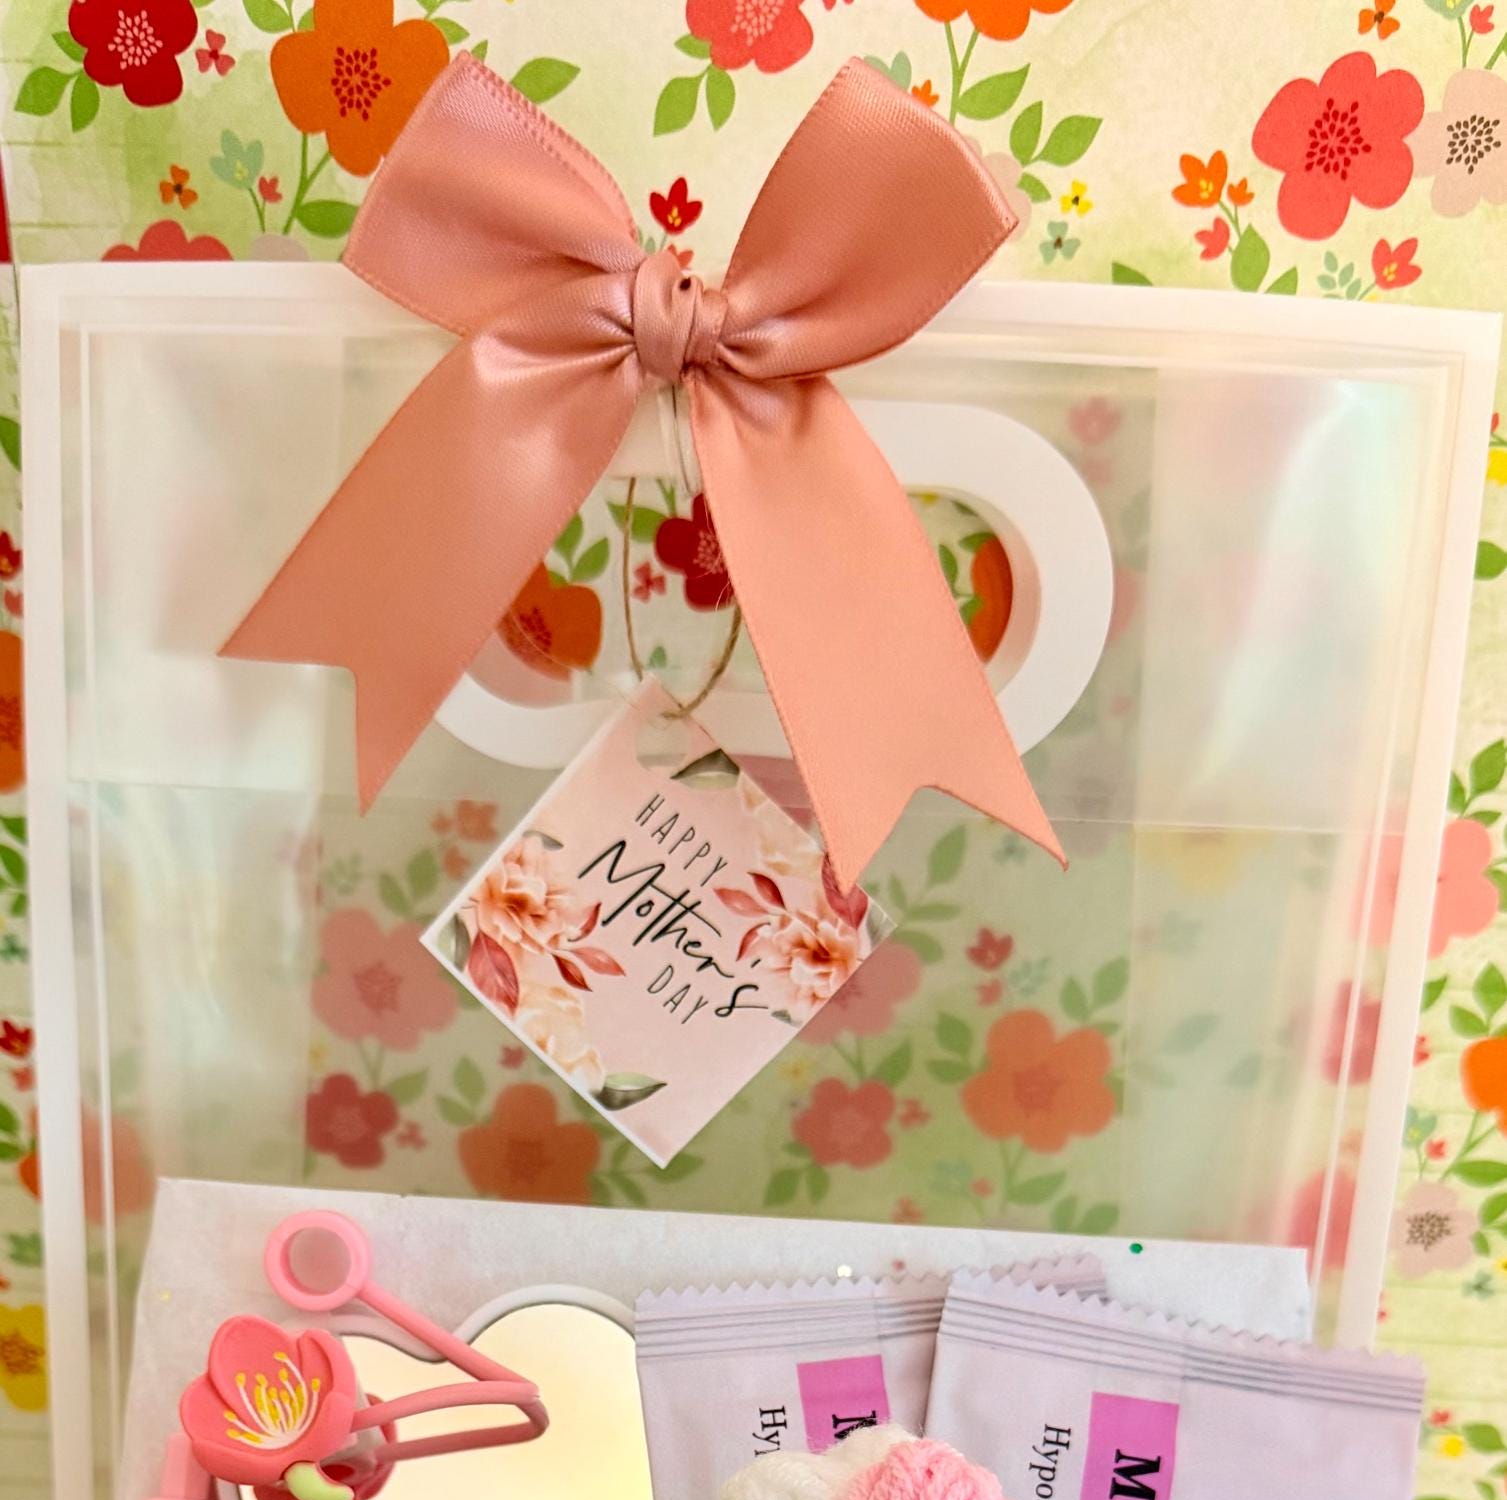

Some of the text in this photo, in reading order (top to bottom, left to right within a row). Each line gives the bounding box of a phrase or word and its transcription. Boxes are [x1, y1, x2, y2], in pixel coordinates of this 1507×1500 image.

[636, 793, 728, 888] HAPPY
[579, 841, 770, 1018] Mother's
[647, 965, 707, 1024] DAY
